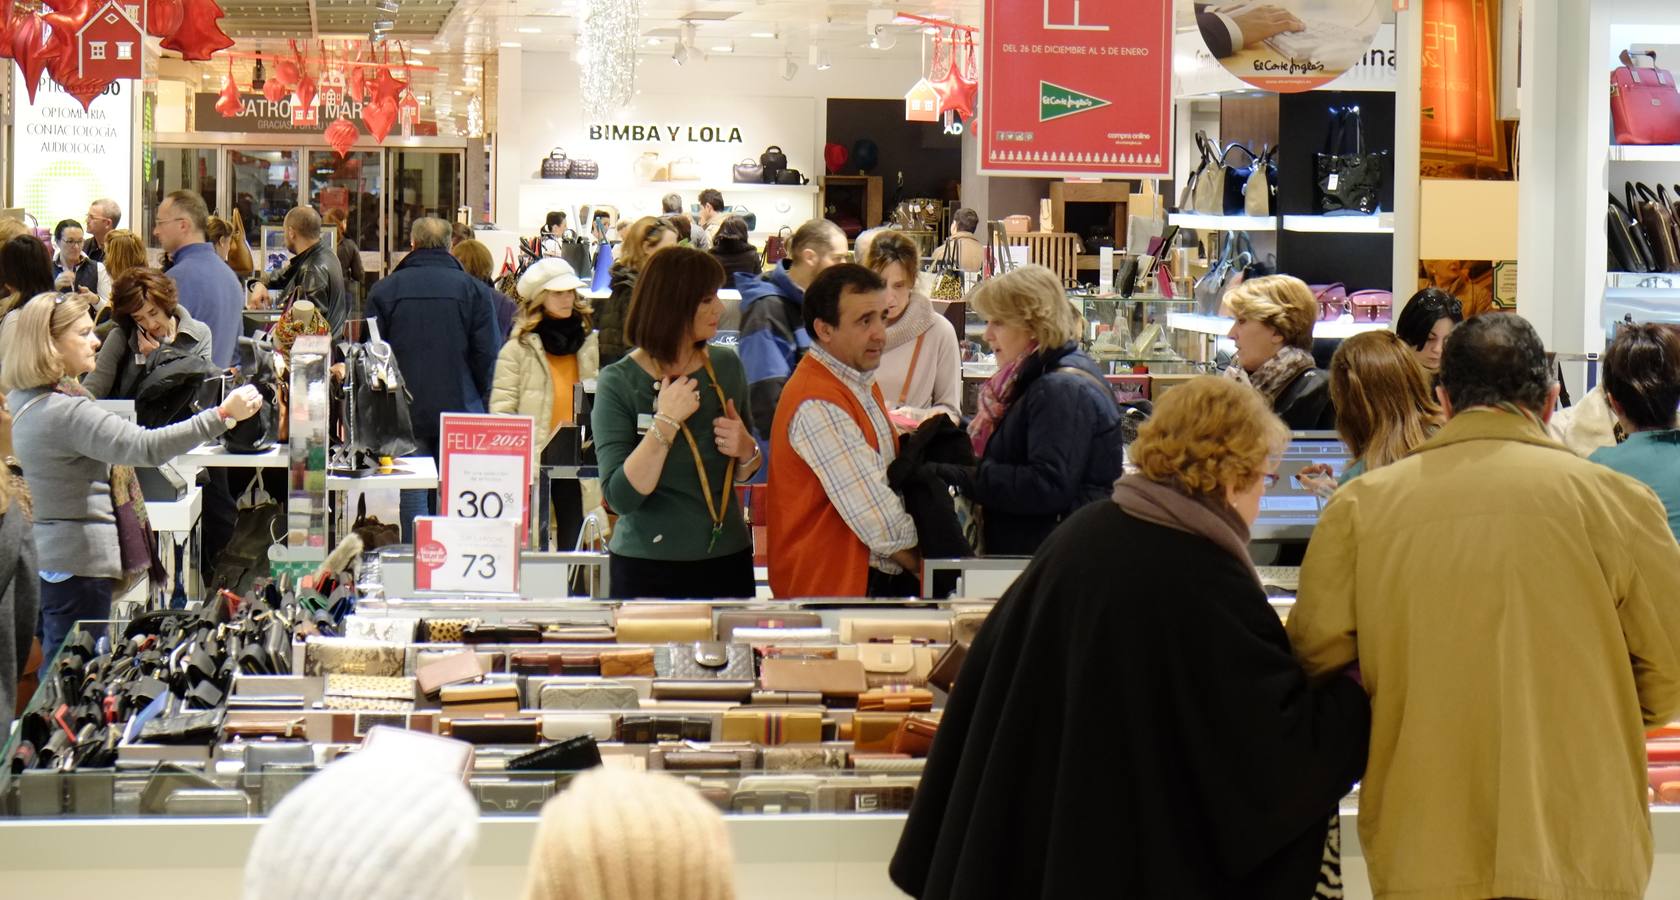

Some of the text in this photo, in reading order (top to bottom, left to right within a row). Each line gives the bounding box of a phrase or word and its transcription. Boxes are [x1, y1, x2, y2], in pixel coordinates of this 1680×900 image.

[1002, 43, 1149, 56] DEL 26 DE DICIEMBRE AL 5 DE ENERO
[1253, 57, 1325, 75] El Corte Inglés
[589, 125, 743, 143] BIMBA Y LOLA
[447, 432, 528, 451] FELIZ 2015
[462, 553, 496, 579] 73
